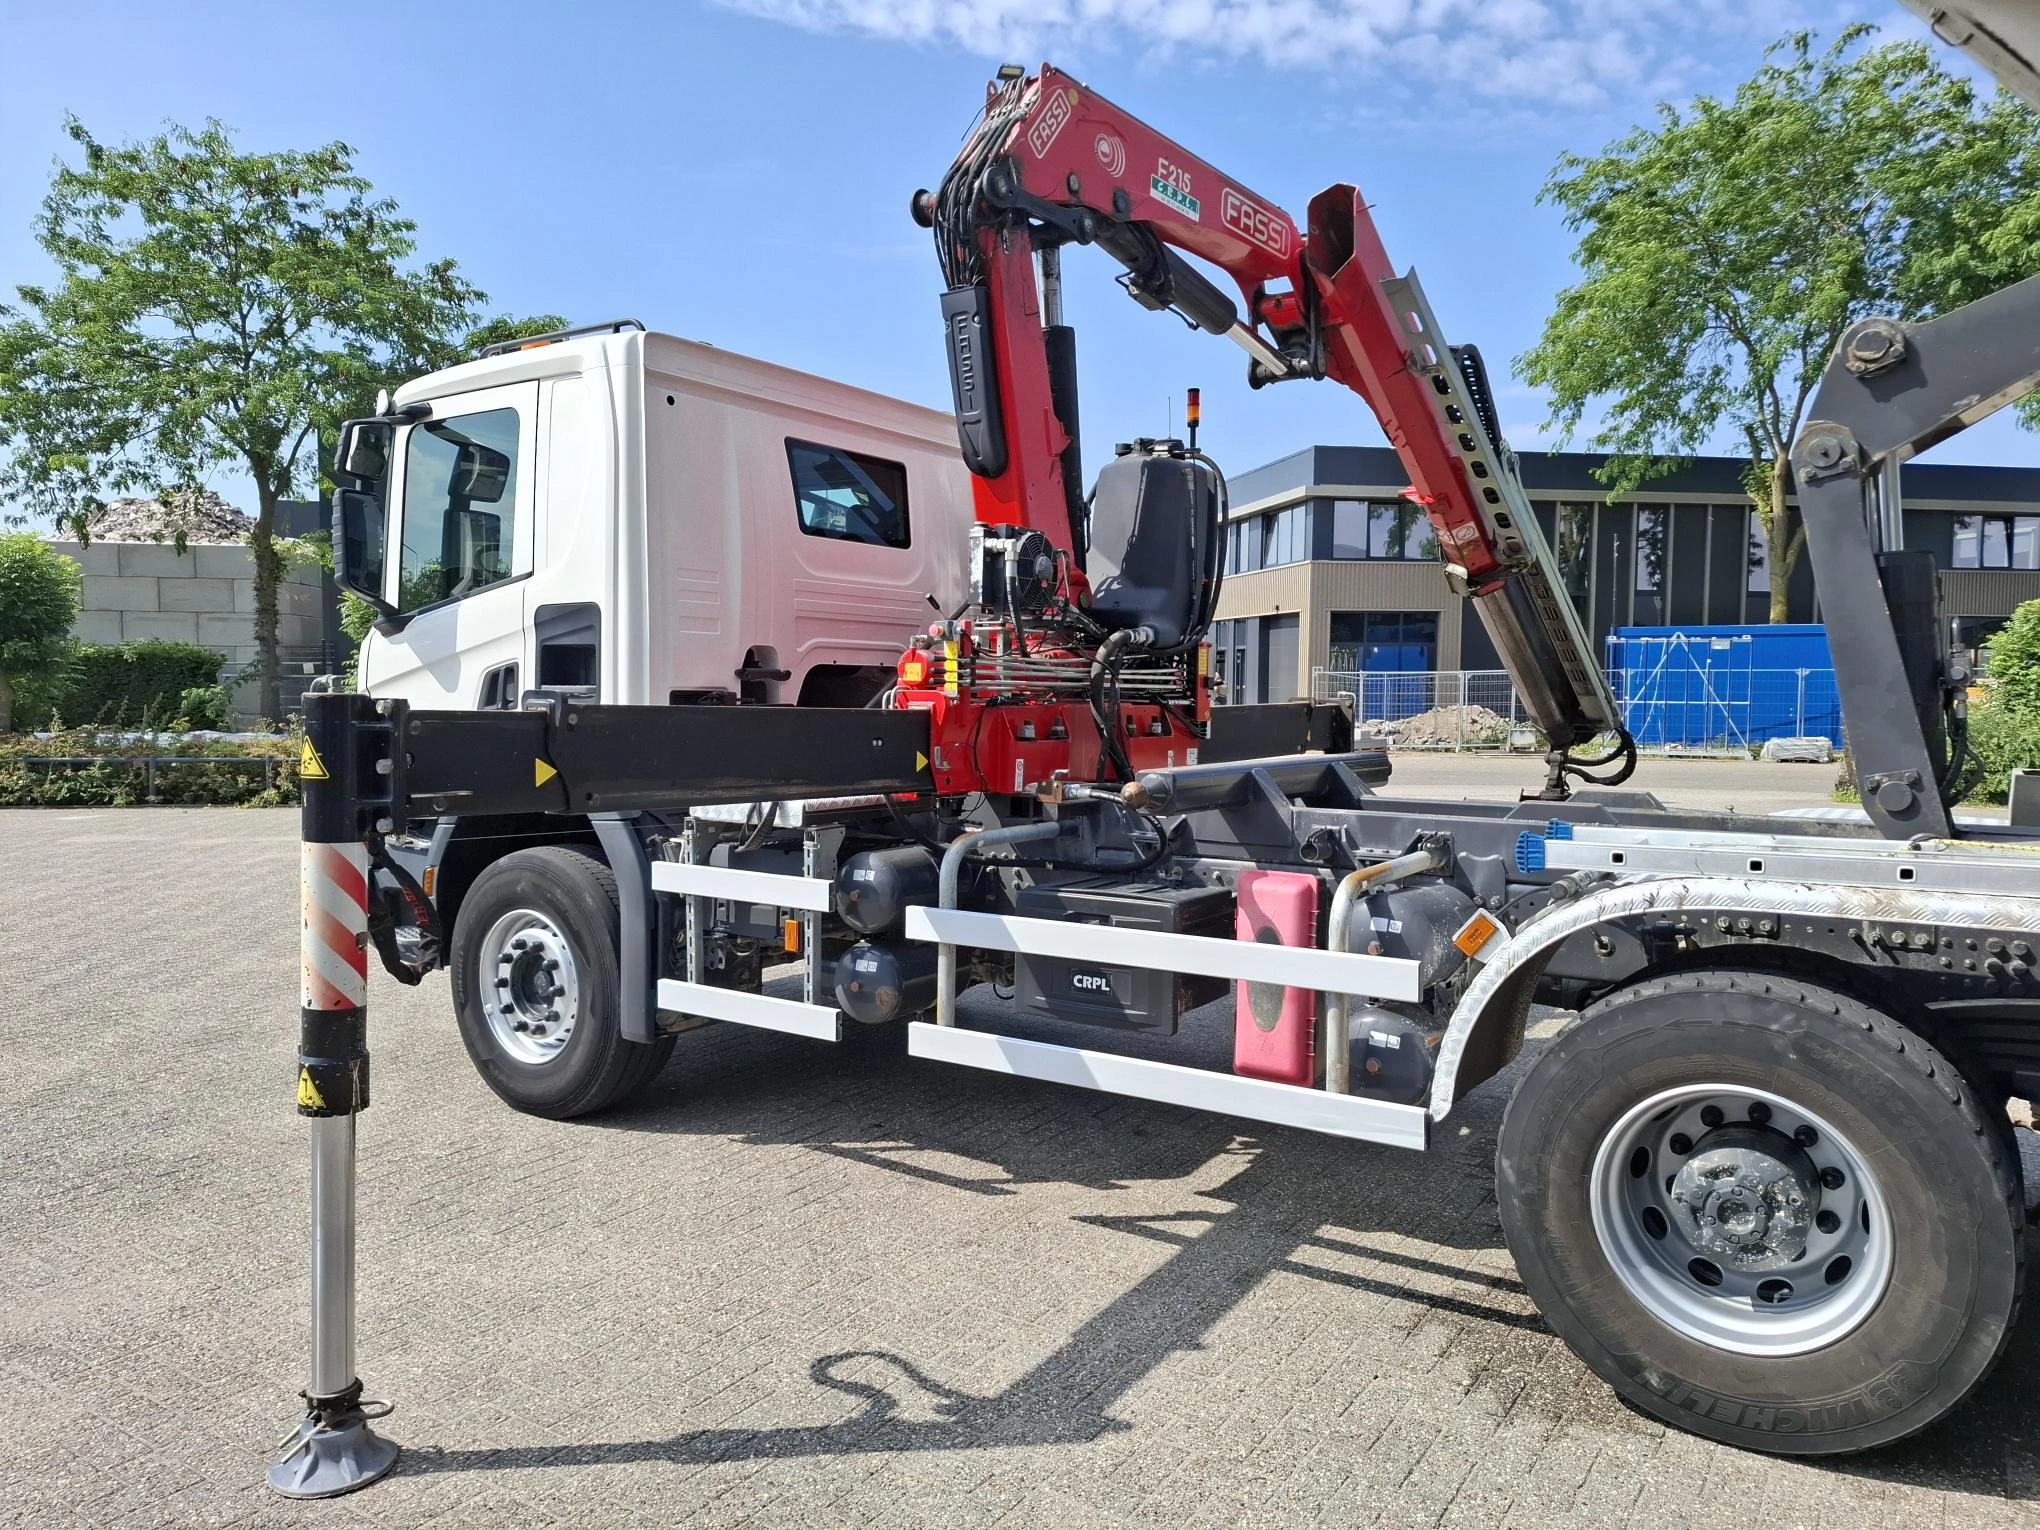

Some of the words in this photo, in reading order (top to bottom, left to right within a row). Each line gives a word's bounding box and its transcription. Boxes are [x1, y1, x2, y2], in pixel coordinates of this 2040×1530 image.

[1032, 97, 1067, 151] FASSI
[1158, 157, 1191, 193] F215
[1226, 195, 1287, 253] FASSI
[957, 315, 976, 410] FASSI
[1073, 974, 1110, 991] CRPL
